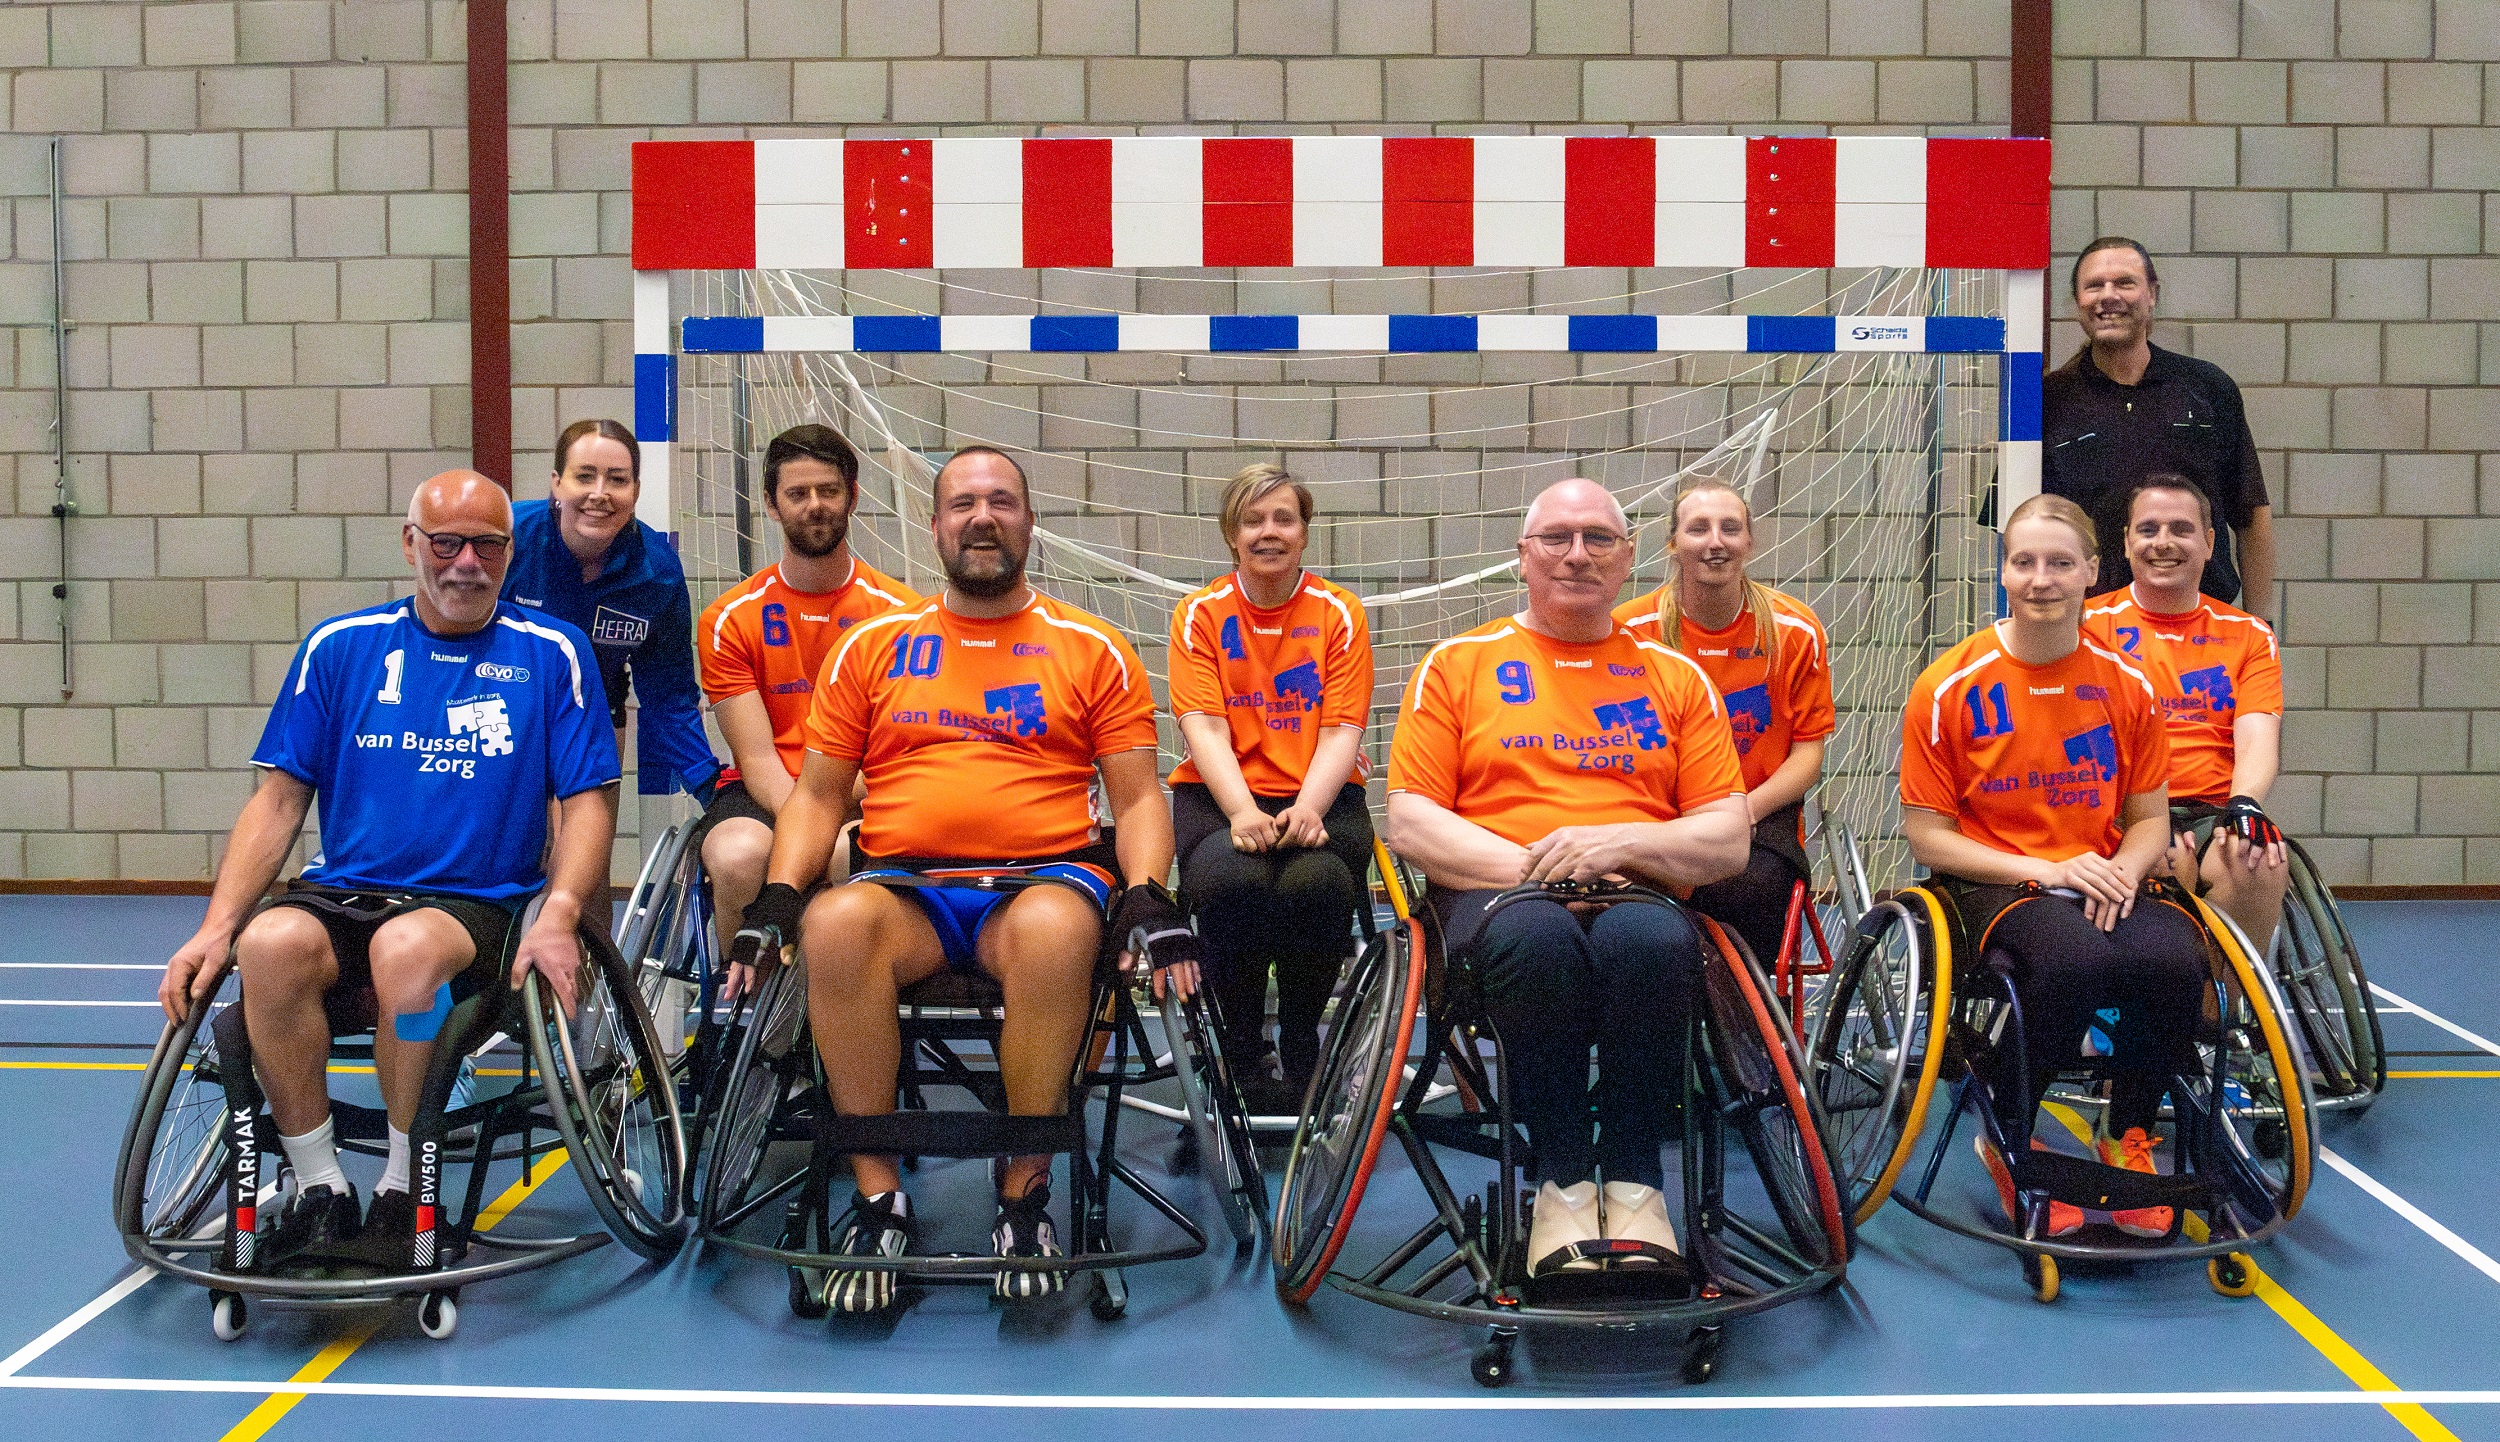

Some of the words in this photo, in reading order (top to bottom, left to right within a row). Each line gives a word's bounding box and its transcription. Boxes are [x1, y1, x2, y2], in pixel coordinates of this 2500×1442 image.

[592, 619, 645, 641] HEFRA
[762, 603, 790, 647] 6
[961, 638, 996, 648] hummel
[1221, 615, 1247, 660] 4
[2116, 626, 2143, 661] 2
[430, 651, 468, 663] hummel
[888, 633, 943, 680] 10
[1554, 659, 1593, 669] hummel
[378, 649, 405, 705] 1
[1495, 660, 1535, 706] 9
[2028, 684, 2065, 695] hummel
[2160, 692, 2208, 709] ussel
[1253, 691, 1301, 713] Bssel
[1966, 682, 2015, 739] 11
[891, 710, 928, 724] van
[938, 708, 1012, 732] Bussel
[355, 733, 393, 749] van
[402, 732, 477, 753] Bussel
[1500, 735, 1544, 750] van
[1553, 729, 1633, 751] Bussel
[418, 754, 476, 779] Zorg
[1576, 753, 1635, 775] Zorg
[1980, 776, 2019, 793] van
[2028, 762, 2098, 788] Bussel
[2046, 787, 2101, 808] Zorg
[234, 1106, 254, 1202] TARMAK
[421, 1141, 437, 1204] BW500
